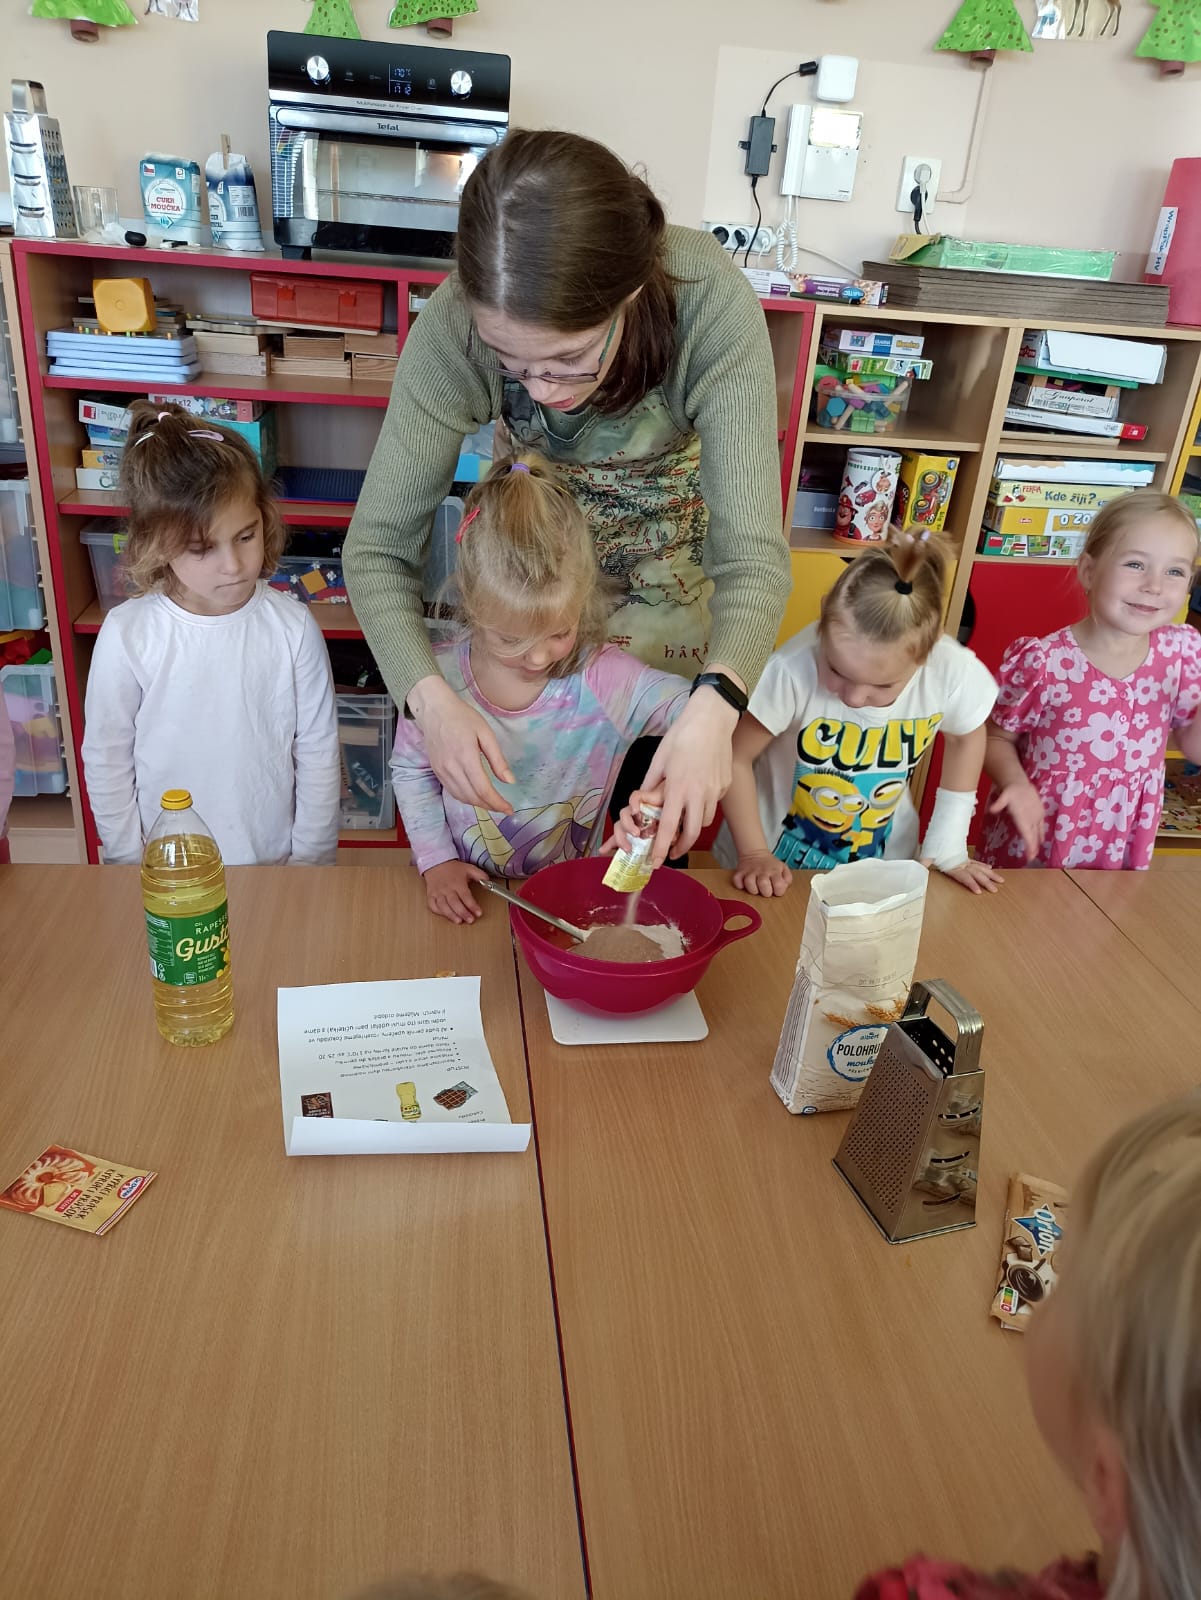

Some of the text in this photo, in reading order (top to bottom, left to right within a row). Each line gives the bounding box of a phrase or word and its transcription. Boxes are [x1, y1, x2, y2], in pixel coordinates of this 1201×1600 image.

[377, 122, 400, 132] Tefal
[150, 202, 181, 212] MOUČKA
[1154, 257, 1162, 271] HV
[1045, 490, 1067, 502] Kde
[860, 1032, 879, 1040] albert
[1033, 1208, 1055, 1252] Orion
